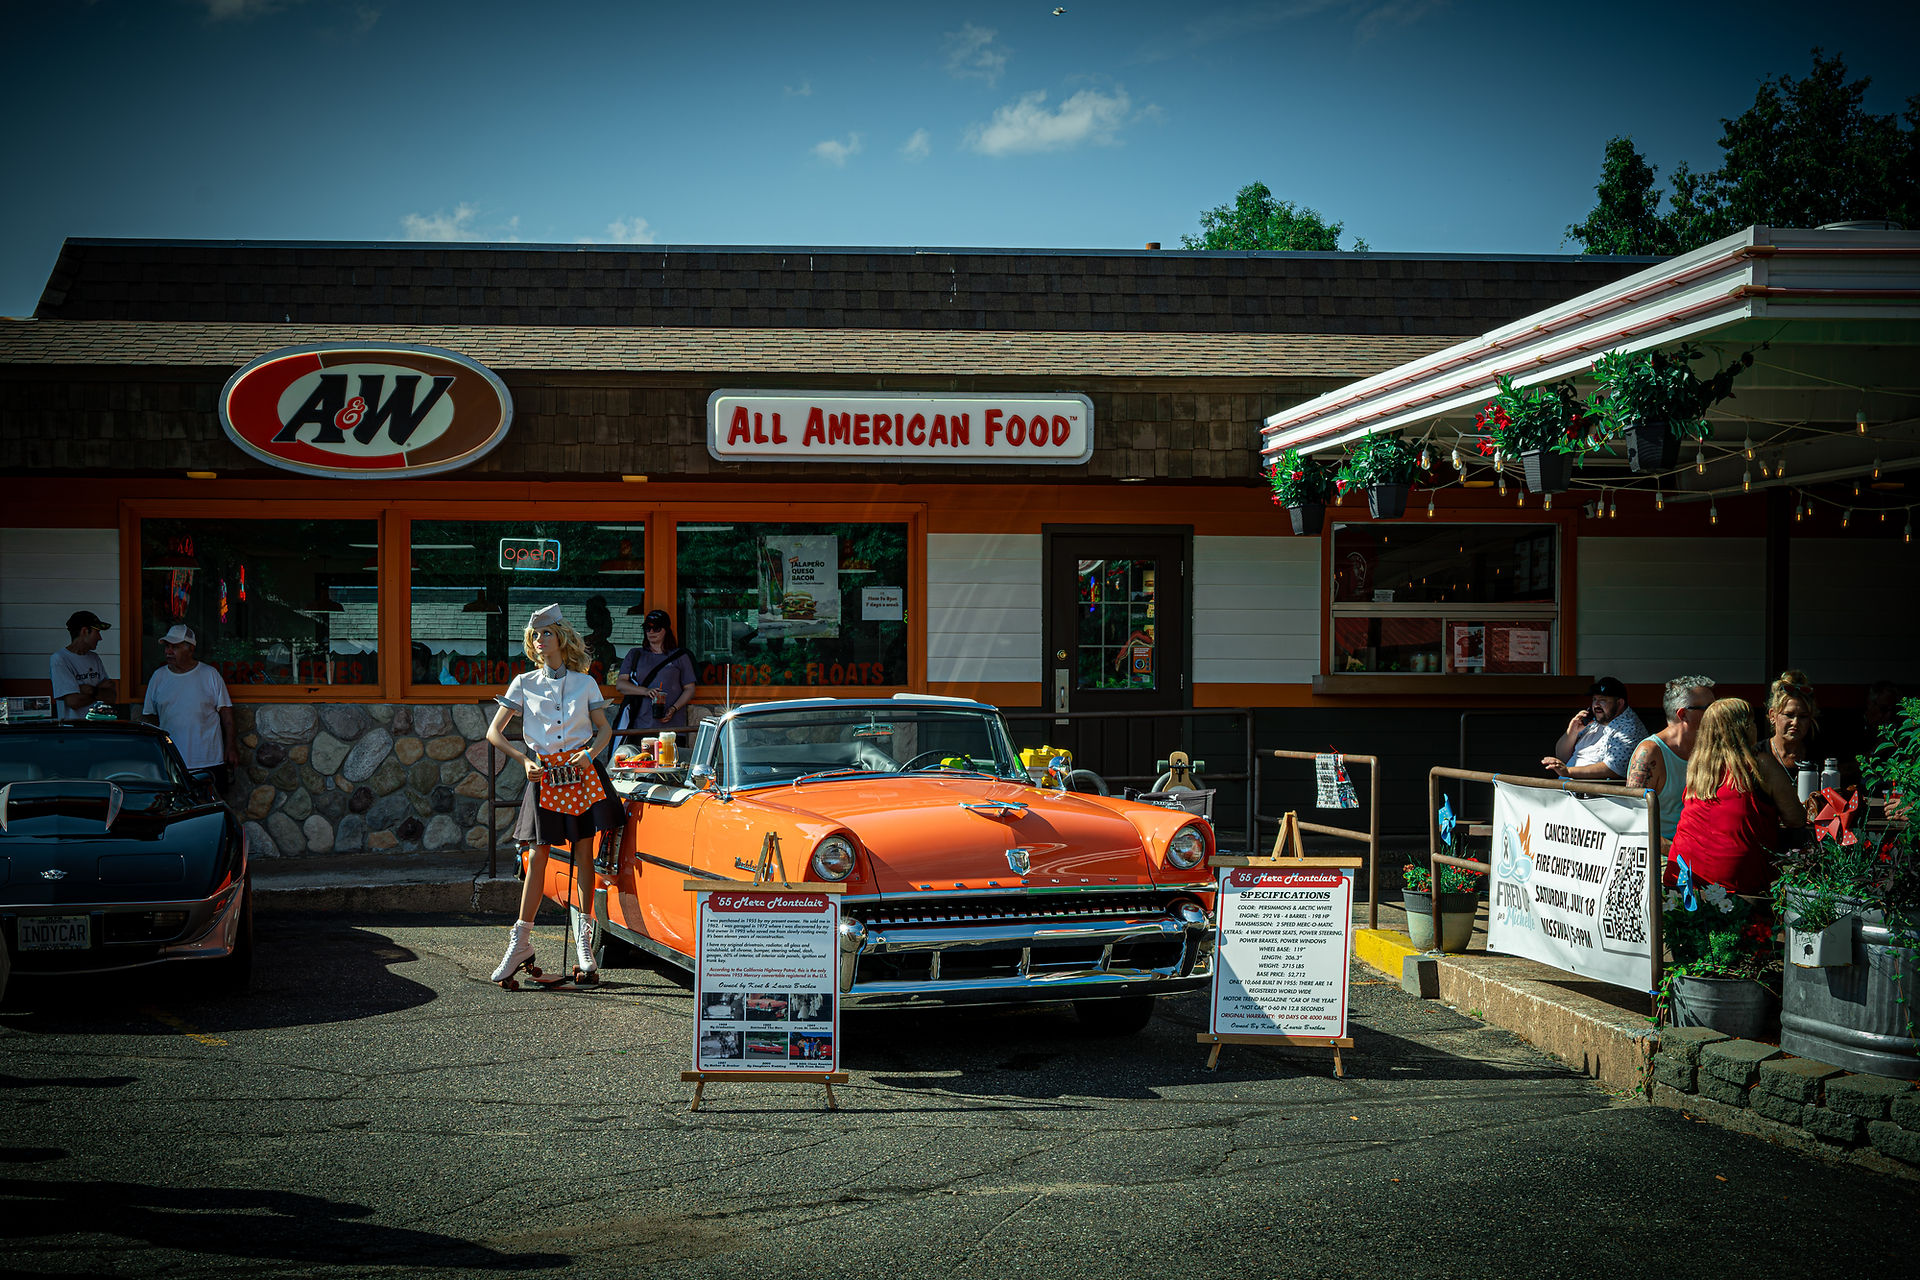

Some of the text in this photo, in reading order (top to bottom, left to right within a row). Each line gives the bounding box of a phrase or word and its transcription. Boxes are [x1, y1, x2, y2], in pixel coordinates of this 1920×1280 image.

[271, 374, 456, 446] A&W
[727, 406, 787, 446] ALL
[802, 406, 970, 448] AMERICAN
[504, 548, 555, 564] open
[806, 662, 885, 685] FLOATS
[1545, 822, 1606, 850] CANCER BENEFIT
[1536, 853, 1550, 872] FIRE
[1551, 856, 1576, 878] CHIEF'S
[1253, 873, 1282, 884] Merc
[1284, 873, 1337, 884] Montclair
[734, 897, 765, 909] Merc
[767, 897, 823, 909] Montclair
[1535, 885, 1595, 917] SATURDAY, JULY 18
[22, 925, 85, 942] INDYCAR
